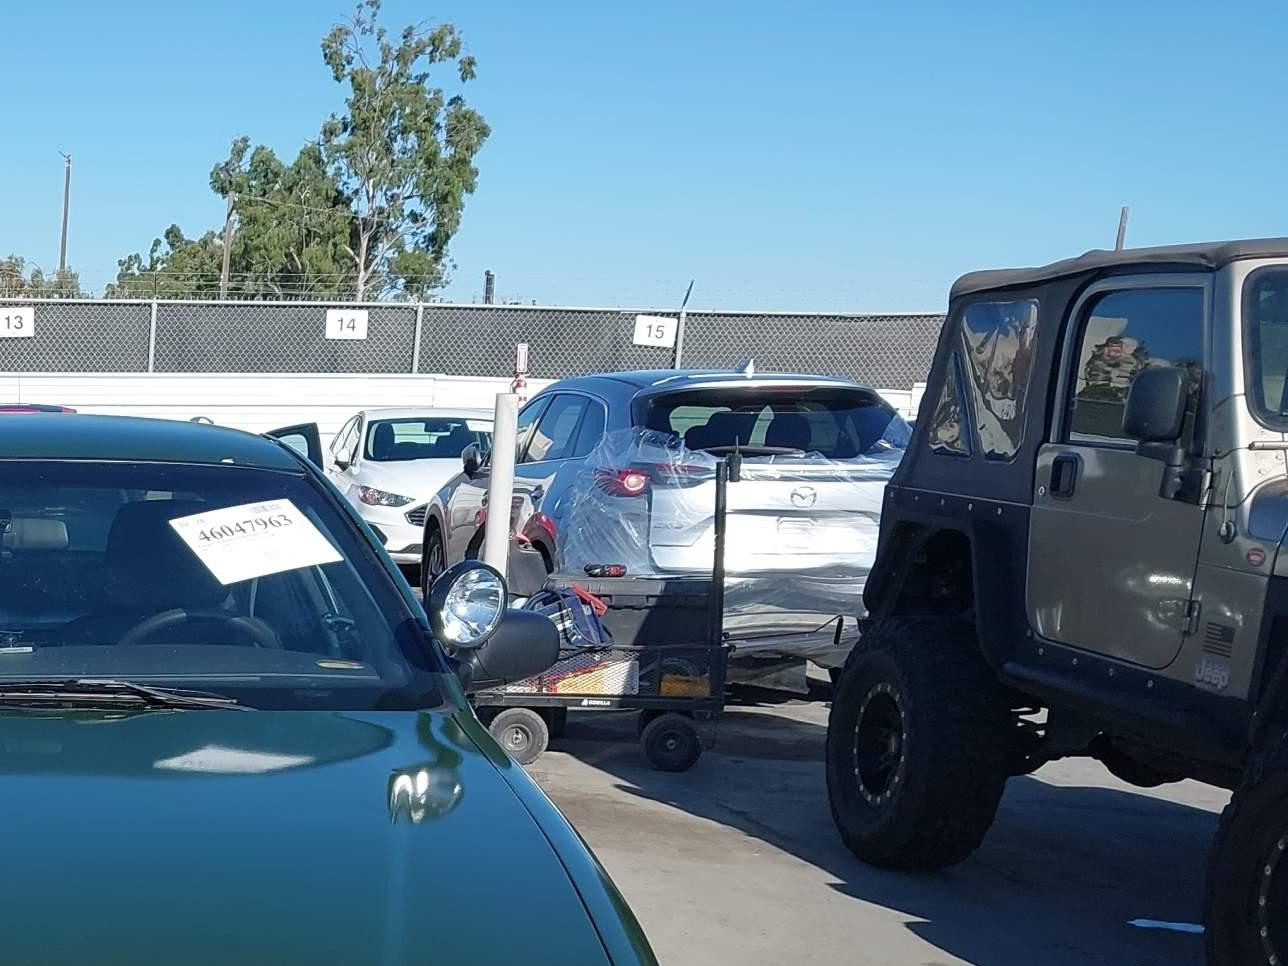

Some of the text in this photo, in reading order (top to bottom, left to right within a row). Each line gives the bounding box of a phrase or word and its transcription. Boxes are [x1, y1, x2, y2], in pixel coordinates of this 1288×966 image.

[4, 315, 24, 330] 13
[337, 317, 356, 332] 14
[646, 324, 665, 339] 15
[198, 513, 293, 542] 46047963
[1195, 659, 1228, 689] Jeep
